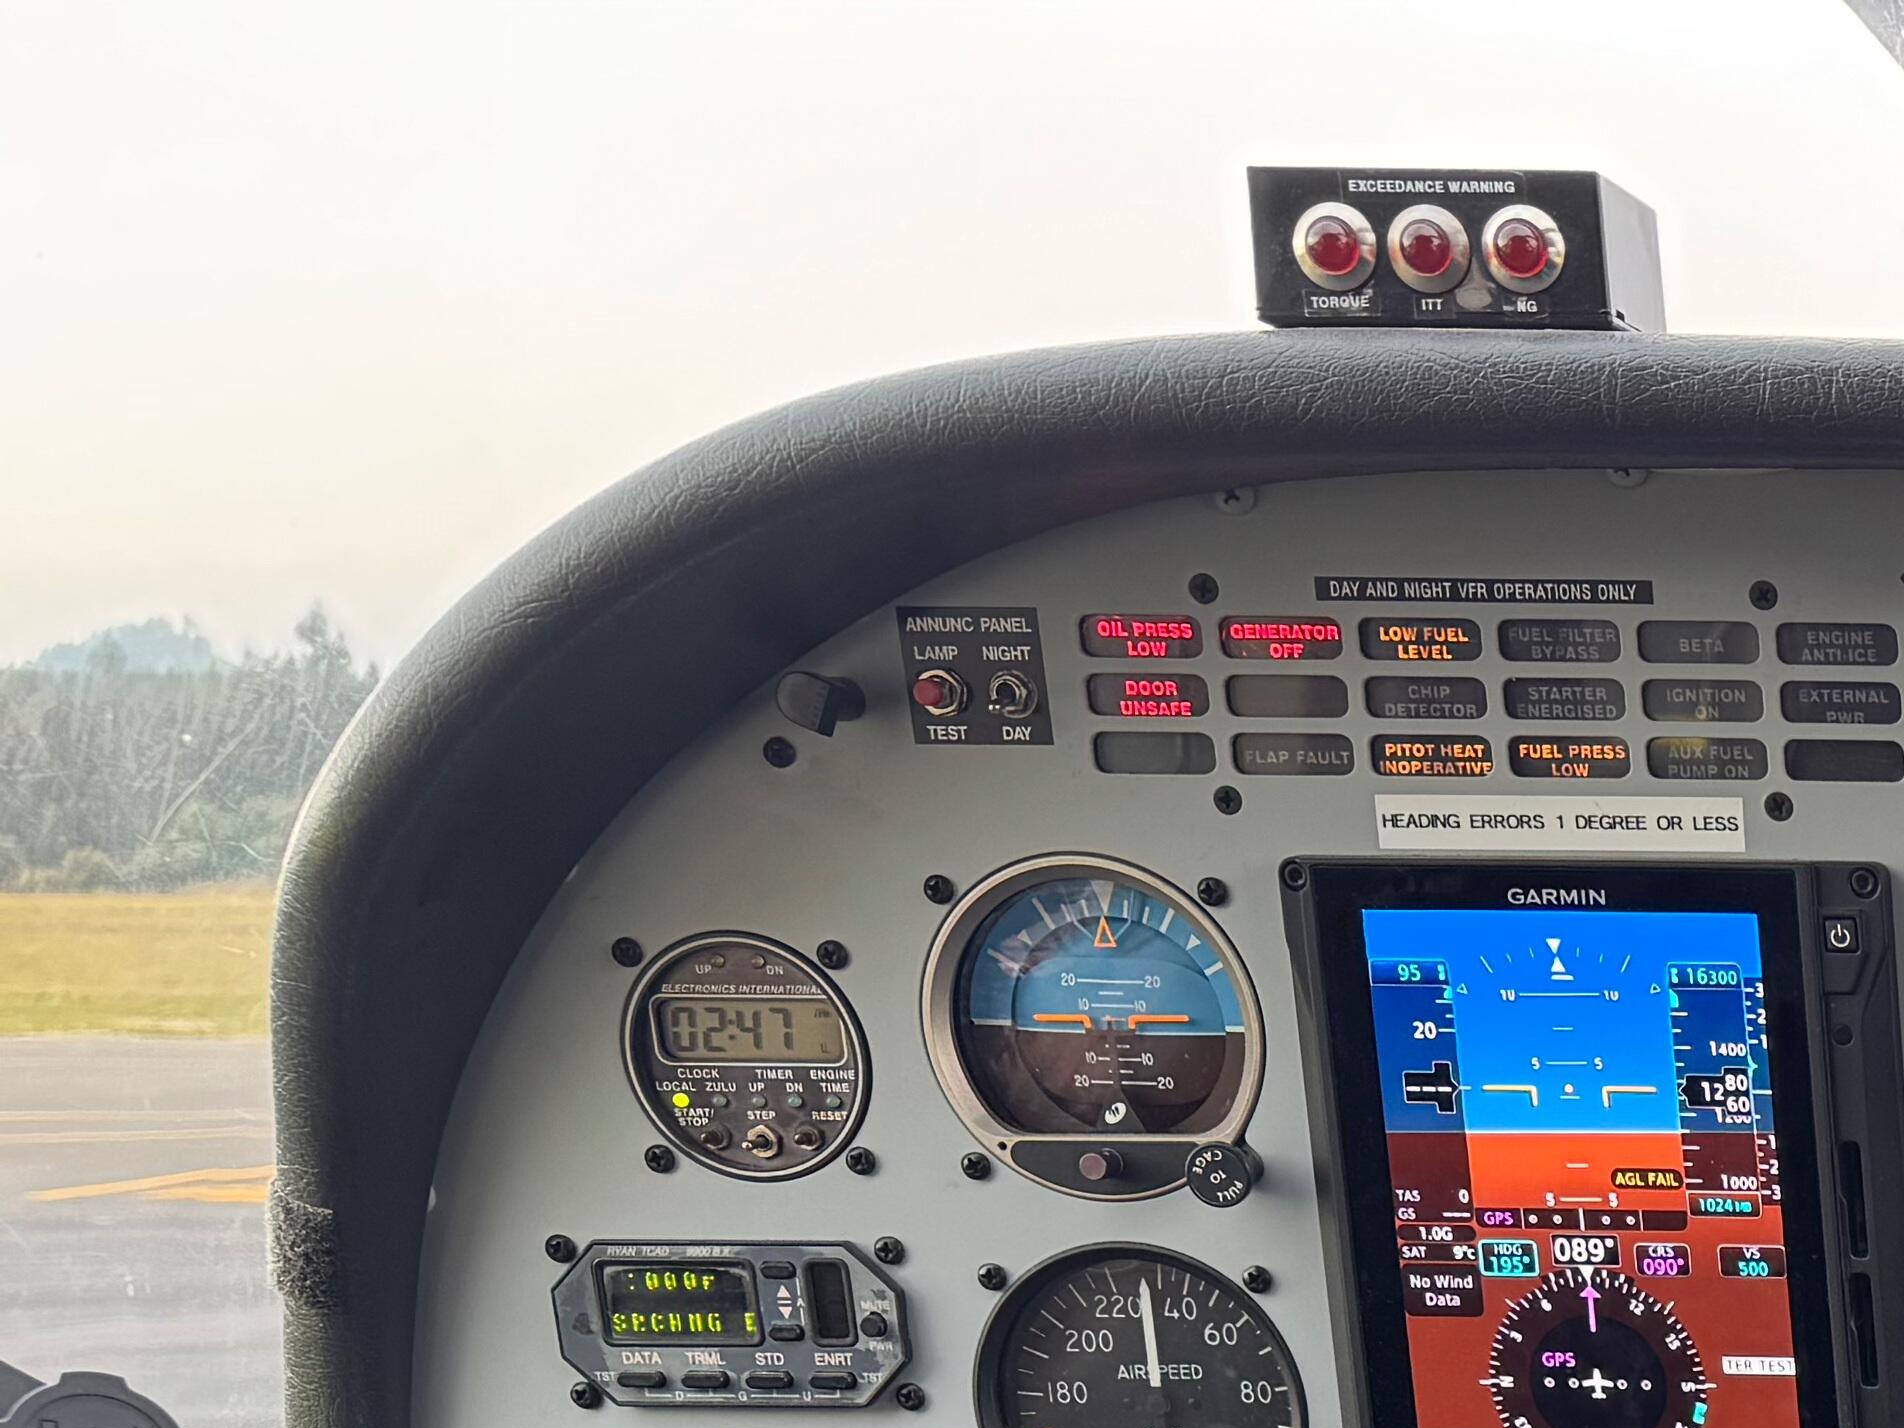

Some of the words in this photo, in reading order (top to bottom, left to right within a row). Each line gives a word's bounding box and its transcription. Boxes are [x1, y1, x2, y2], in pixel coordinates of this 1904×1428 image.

[1348, 180, 1445, 193] EXCEEDANCE
[1448, 180, 1515, 193] WARNING
[1311, 295, 1370, 309] TORQUE
[1421, 299, 1443, 311] ITT
[1330, 582, 1361, 598] DAY
[1366, 582, 1399, 598] AND
[1404, 583, 1453, 598] NIGHT
[1457, 583, 1488, 599] VFR
[1494, 583, 1591, 600] OPERATIONS
[1598, 584, 1637, 601] ONLY
[906, 617, 974, 633] ANNUNC
[981, 617, 1031, 633] PANEL
[1097, 622, 1128, 638] OIL
[1133, 623, 1192, 639] PRESS
[1230, 624, 1338, 641] GENERATOR
[1379, 627, 1417, 643] LOW
[1423, 627, 1468, 643] FUEL
[914, 646, 958, 660] LAMP
[982, 646, 1030, 661] NIGHT
[1127, 641, 1165, 657] LOW
[1270, 643, 1304, 658] OFF
[1398, 643, 1452, 660] LEVEL
[1126, 681, 1176, 696] DOOR
[1120, 701, 1191, 717] UNSAFE
[927, 726, 967, 740] TEST
[1002, 726, 1031, 741] DAY
[1385, 743, 1434, 758] PITOT
[1441, 744, 1484, 759] HEAT
[1519, 744, 1563, 759] FUEL
[1568, 745, 1626, 761] PRESS
[1380, 761, 1493, 776] INOPERATIVE
[1551, 762, 1589, 777] LOW
[1382, 814, 1460, 830] HEADING
[1470, 815, 1545, 830] ERRORS
[1556, 815, 1564, 829] 1
[1575, 815, 1647, 831] DEGREE
[1657, 815, 1684, 831] OR
[1693, 816, 1738, 832] LESS
[1507, 888, 1606, 906] GARMIN
[1686, 969, 1737, 985] 16300
[1616, 1172, 1643, 1186] AGL
[1647, 1172, 1679, 1187] FAIL
[1554, 1237, 1615, 1263] 089°
[1410, 1275, 1429, 1289] No
[1435, 1273, 1472, 1290] Wind
[1425, 1293, 1460, 1308] Data
[1066, 1330, 1114, 1352] 200
[1240, 1382, 1272, 1404] 80
